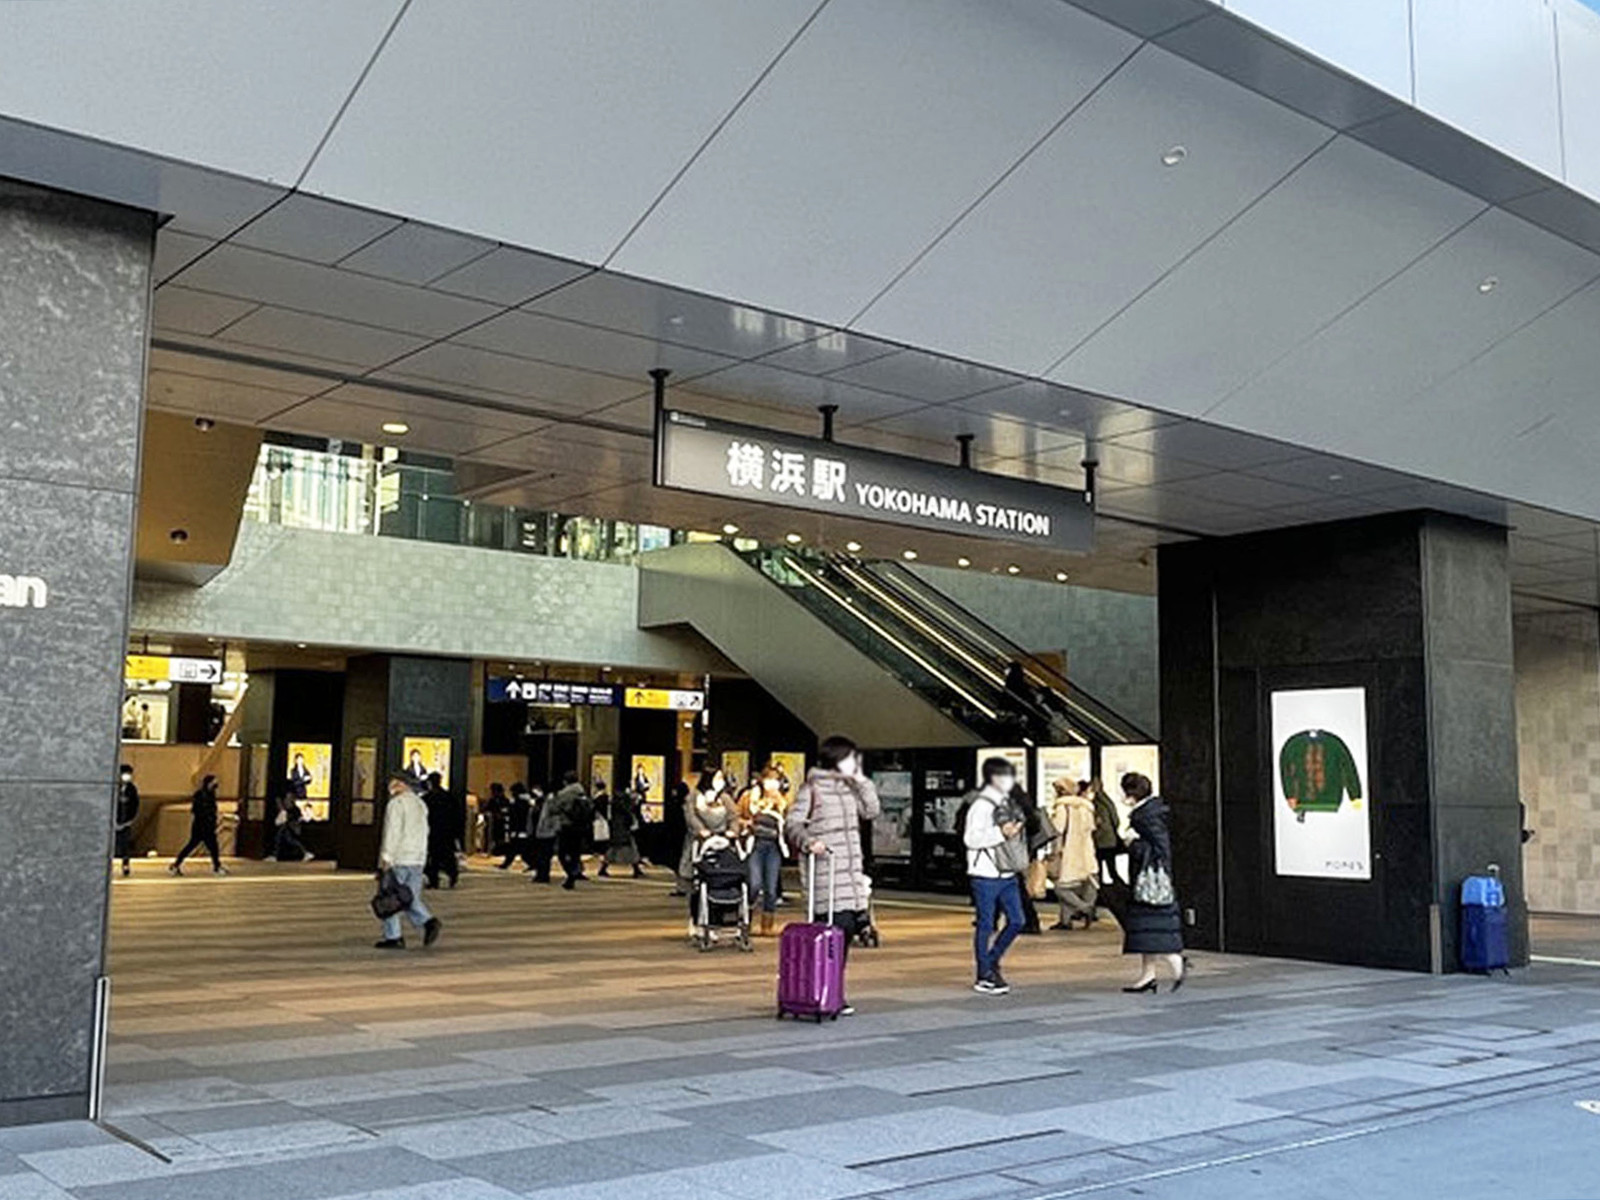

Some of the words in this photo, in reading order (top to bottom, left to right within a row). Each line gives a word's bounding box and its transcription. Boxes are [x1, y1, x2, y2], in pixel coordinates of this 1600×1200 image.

[726, 441, 847, 503] 横浜駅
[855, 483, 972, 523] YOKOHAMA
[975, 503, 1050, 536] STATION
